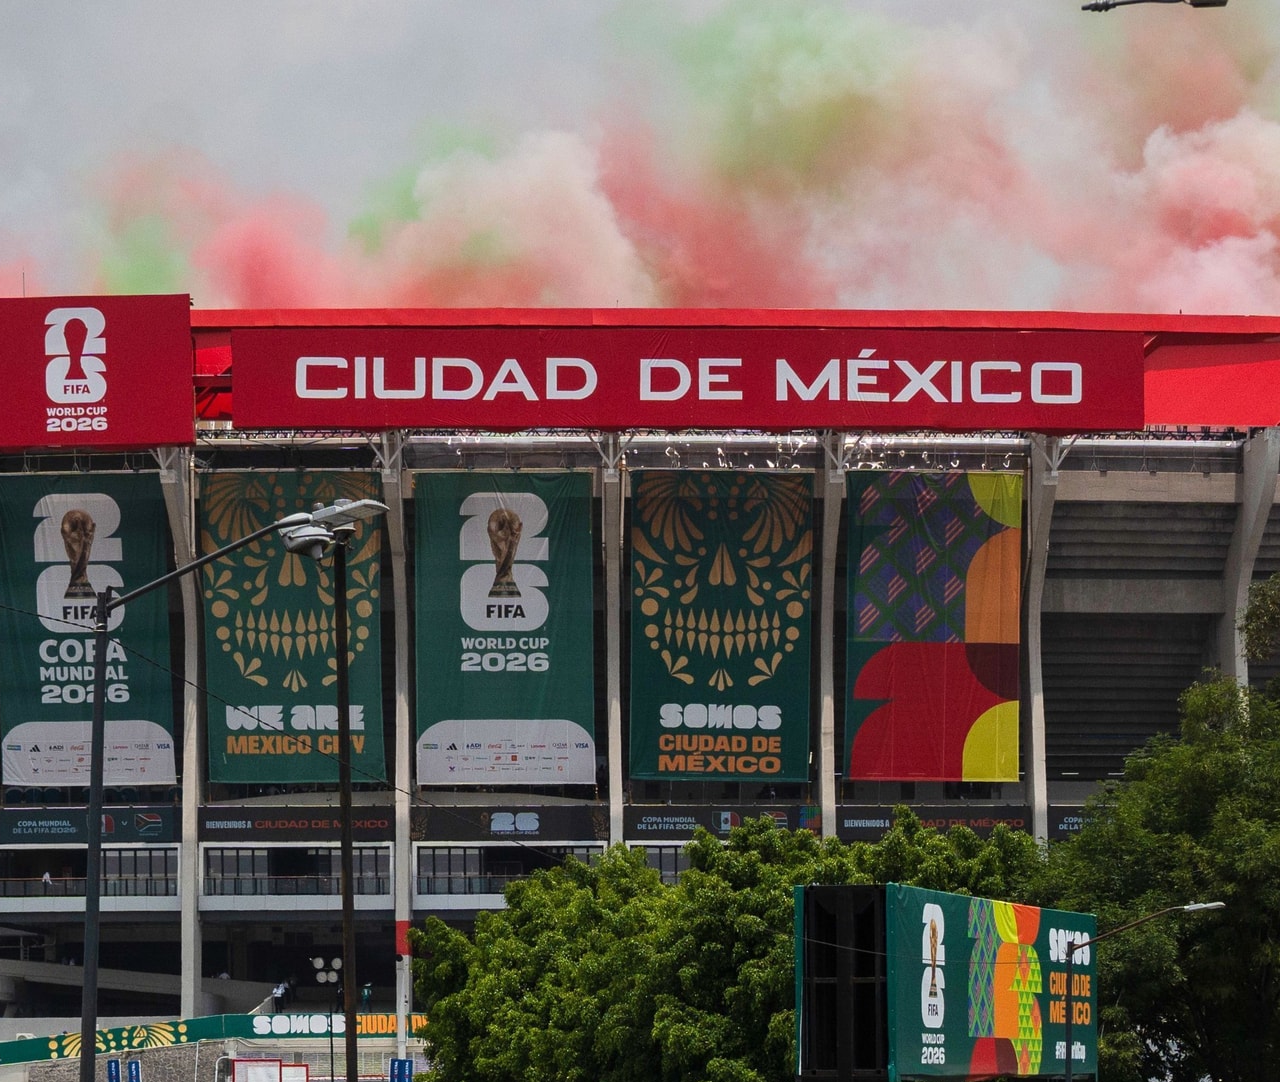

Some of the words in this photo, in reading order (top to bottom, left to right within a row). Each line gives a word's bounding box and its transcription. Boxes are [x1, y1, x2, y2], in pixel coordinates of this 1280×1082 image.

[295, 356, 598, 401] CIUDAD
[640, 357, 743, 402] DE
[775, 348, 1083, 405] MÉXICO
[63, 384, 91, 395] FIFA
[46, 406, 85, 417] WORLD
[86, 406, 108, 416] CUP
[46, 417, 109, 432] 2026
[486, 604, 526, 619] FIFA
[461, 637, 516, 650] WORLD
[519, 637, 550, 650] CUP
[460, 652, 550, 672] 2026
[39, 665, 129, 682] MUNDAL
[660, 703, 782, 730] SOMOS
[226, 735, 313, 755] MEXICO
[317, 734, 366, 755] CIY
[658, 734, 748, 752] CIUDAD
[751, 736, 782, 753] DE
[658, 751, 782, 774] MÉXICO
[254, 820, 308, 829] CIUDAD
[311, 820, 330, 828] DE
[1080, 974, 1091, 998] DE
[927, 1003, 939, 1016] FIFA
[1049, 995, 1091, 1025] MÉICO
[253, 1014, 346, 1034] SOMOS
[921, 1033, 936, 1044] WORLD
[936, 1034, 945, 1045] CUP
[921, 1046, 946, 1065] 2026
